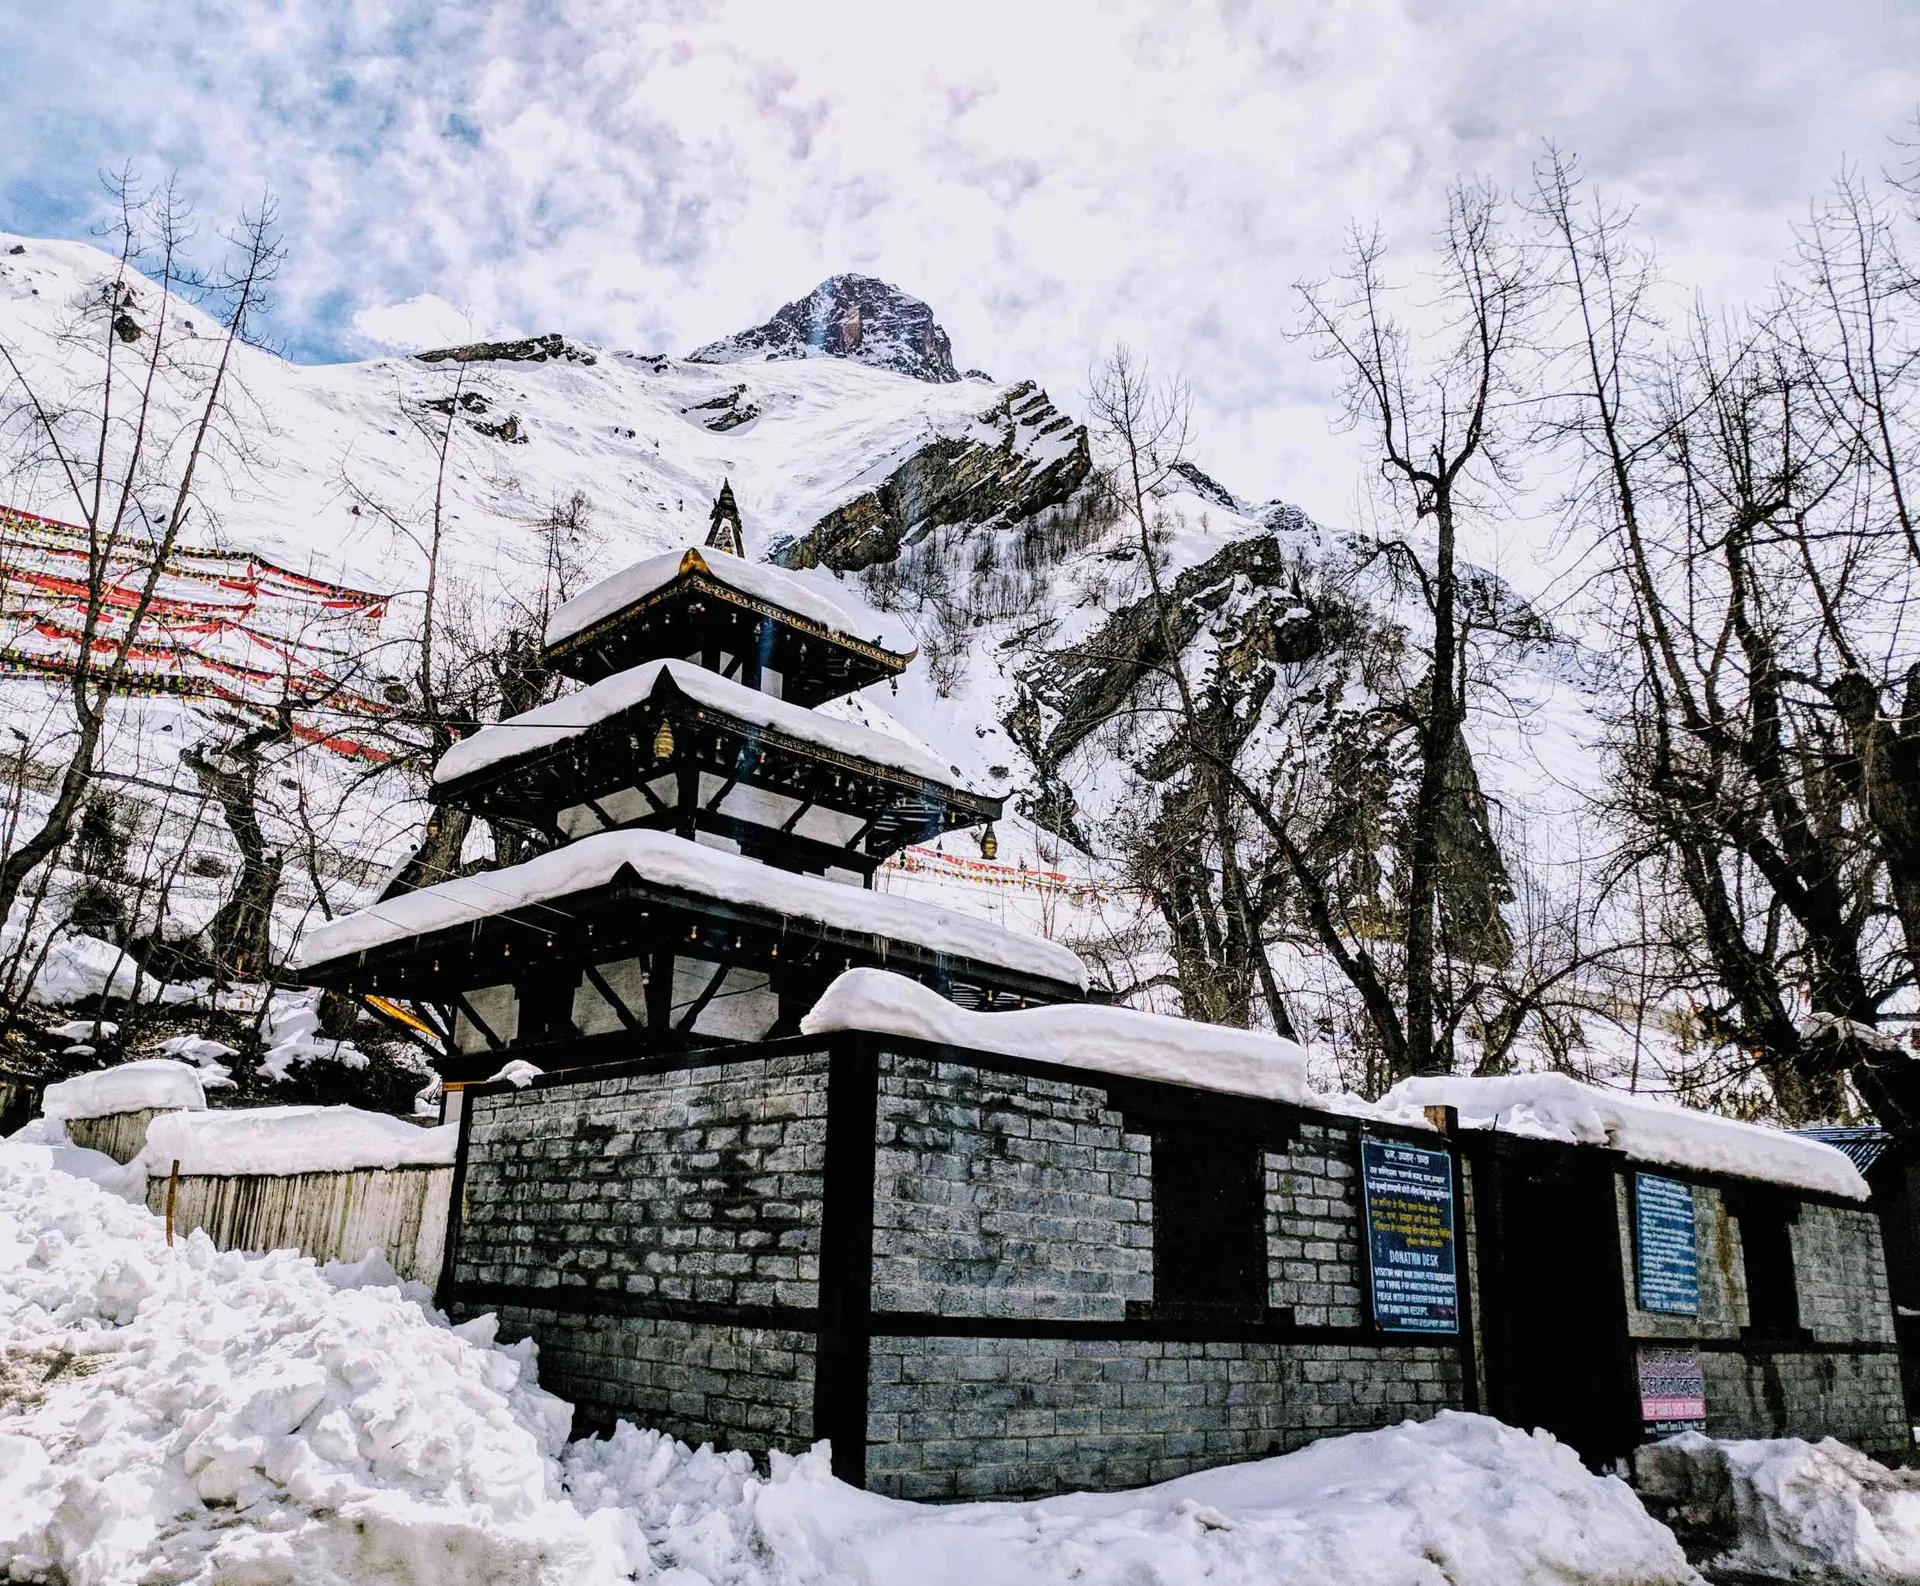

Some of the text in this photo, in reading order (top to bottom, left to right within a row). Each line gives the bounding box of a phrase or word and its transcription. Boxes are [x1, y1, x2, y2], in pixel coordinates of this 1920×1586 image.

[1422, 1253, 1439, 1267] DESK
[1377, 1291, 1392, 1301] PLEASE
[1377, 1303, 1389, 1313] YOUR
